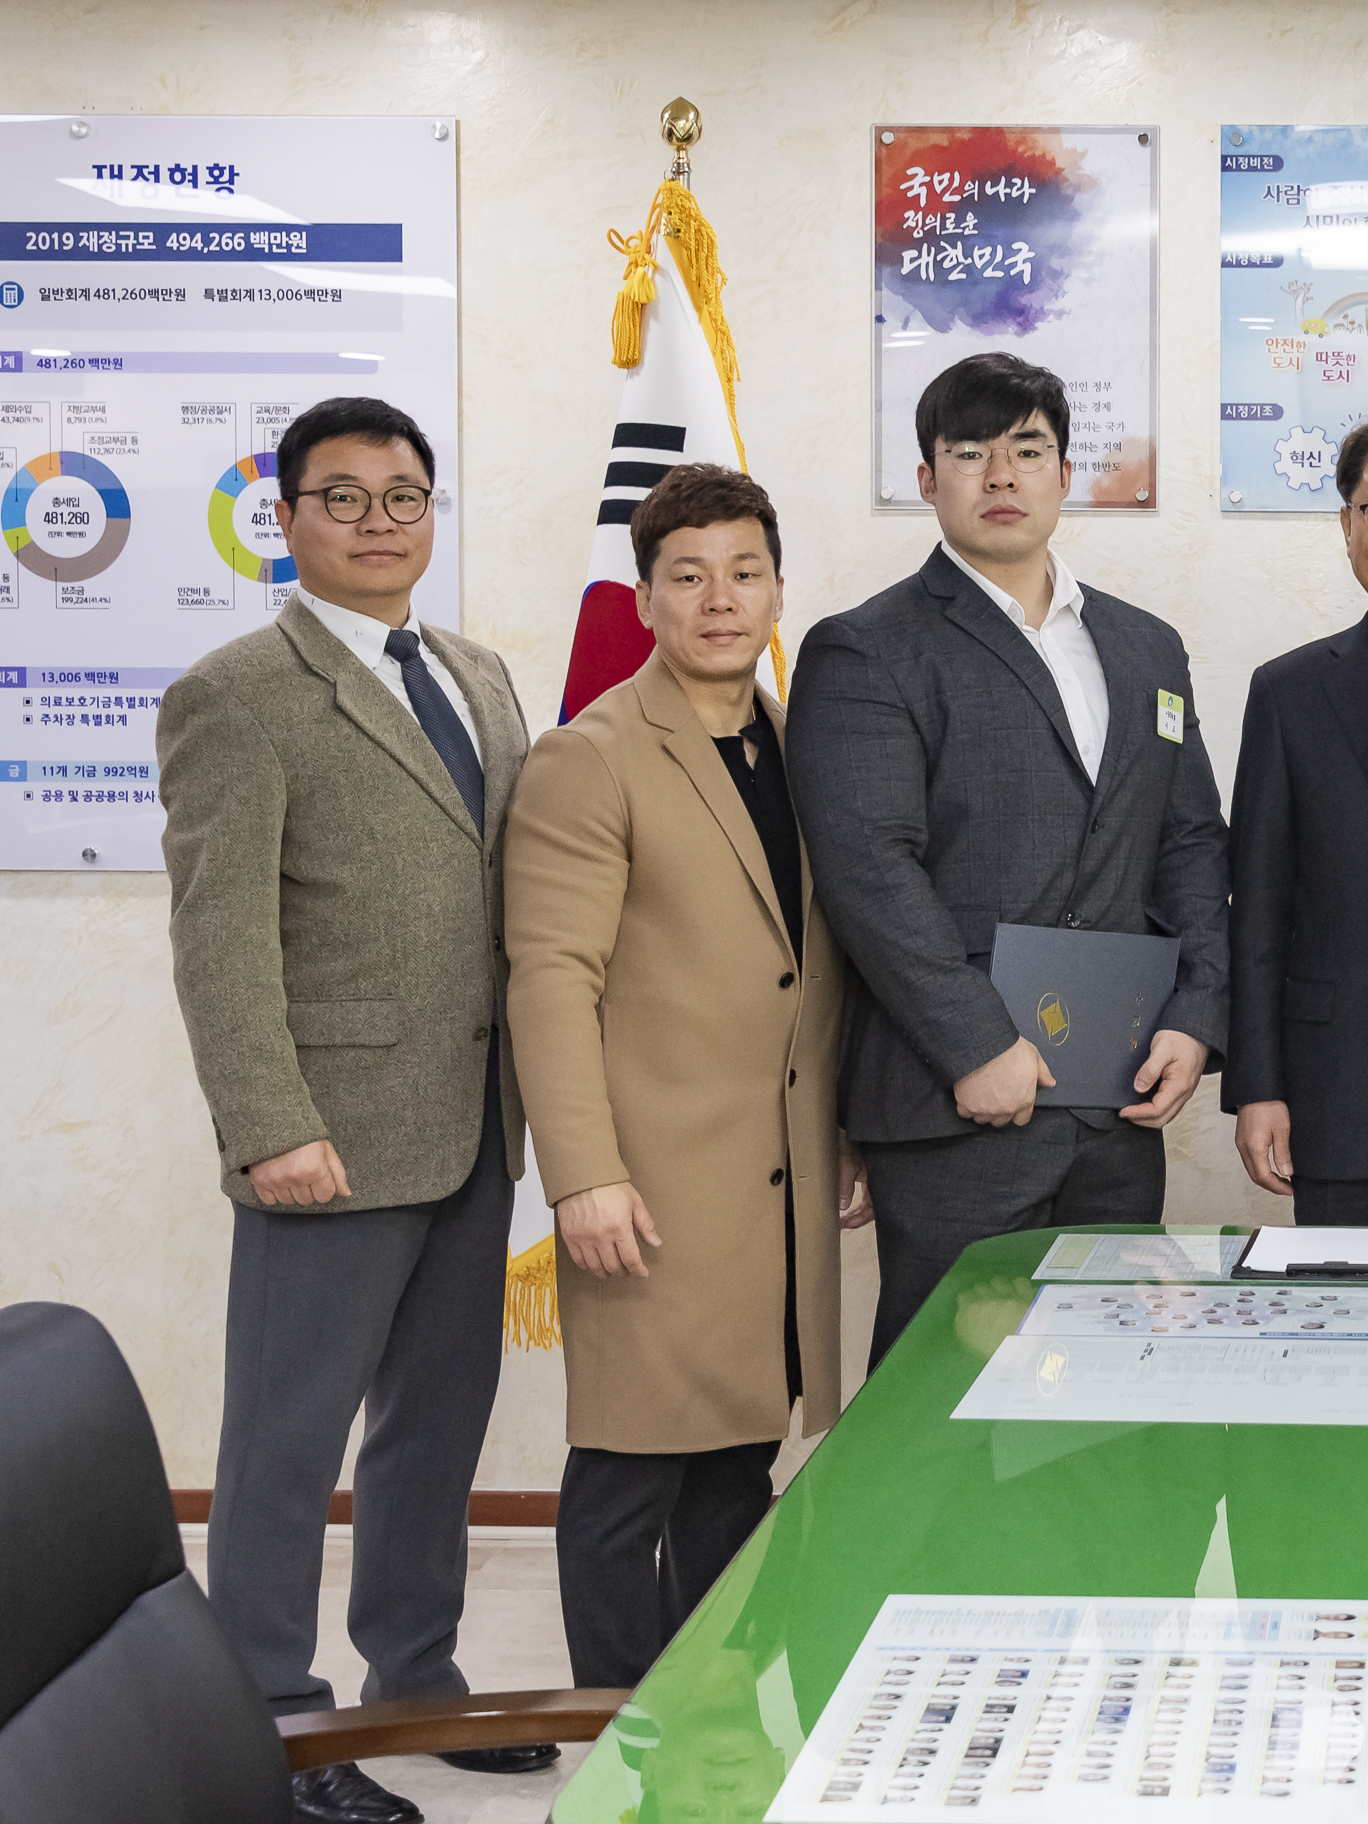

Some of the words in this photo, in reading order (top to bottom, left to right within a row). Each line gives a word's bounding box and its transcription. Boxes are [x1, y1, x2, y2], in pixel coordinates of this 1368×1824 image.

[1225, 156, 1273, 169] 시정비전
[92, 163, 240, 198] 재정현황
[899, 166, 979, 208] 국민의
[984, 175, 1036, 204] 나라
[902, 210, 979, 238] 정의로운
[25, 232, 74, 251] 2019
[78, 231, 156, 252] 재정규모
[166, 233, 245, 254] 494,266
[250, 231, 308, 253] 백만원
[900, 240, 1036, 285] 대한민국
[39, 287, 91, 303] 일반회계
[93, 287, 187, 303] 481,260백만원
[203, 287, 255, 303] 특별회계
[257, 287, 343, 304] 13,006백만원
[1265, 338, 1307, 354] 안전한
[0, 355, 15, 369] 계
[36, 357, 86, 371] 481,260
[88, 356, 123, 370] 백만원
[1272, 356, 1301, 371] 도시
[1315, 351, 1357, 367] 따뜻한
[1321, 369, 1350, 383] 도시
[1092, 381, 1112, 392] 정부
[255, 405, 290, 415] 교육/문화
[1091, 401, 1112, 413] 경제
[1225, 405, 1273, 418] 시정기조
[1105, 421, 1126, 433] 국가
[1102, 441, 1122, 453] 지역
[1289, 450, 1322, 468] 혁신
[1091, 461, 1122, 472] 한반도
[43, 511, 90, 526] 481,260
[177, 588, 200, 597] 인건비
[41, 672, 81, 685] 13,006
[84, 671, 119, 684] 백만원
[40, 696, 161, 709] 의료보호기금특별회계
[40, 714, 76, 726] 주차장
[80, 714, 128, 726] 특별회계
[41, 765, 68, 778] 11개
[74, 765, 97, 778] 기금
[103, 765, 149, 778] 992억원
[41, 790, 64, 803] 공용
[68, 790, 79, 803] 및
[82, 790, 129, 803] 공공용의
[132, 790, 156, 803] 청사
